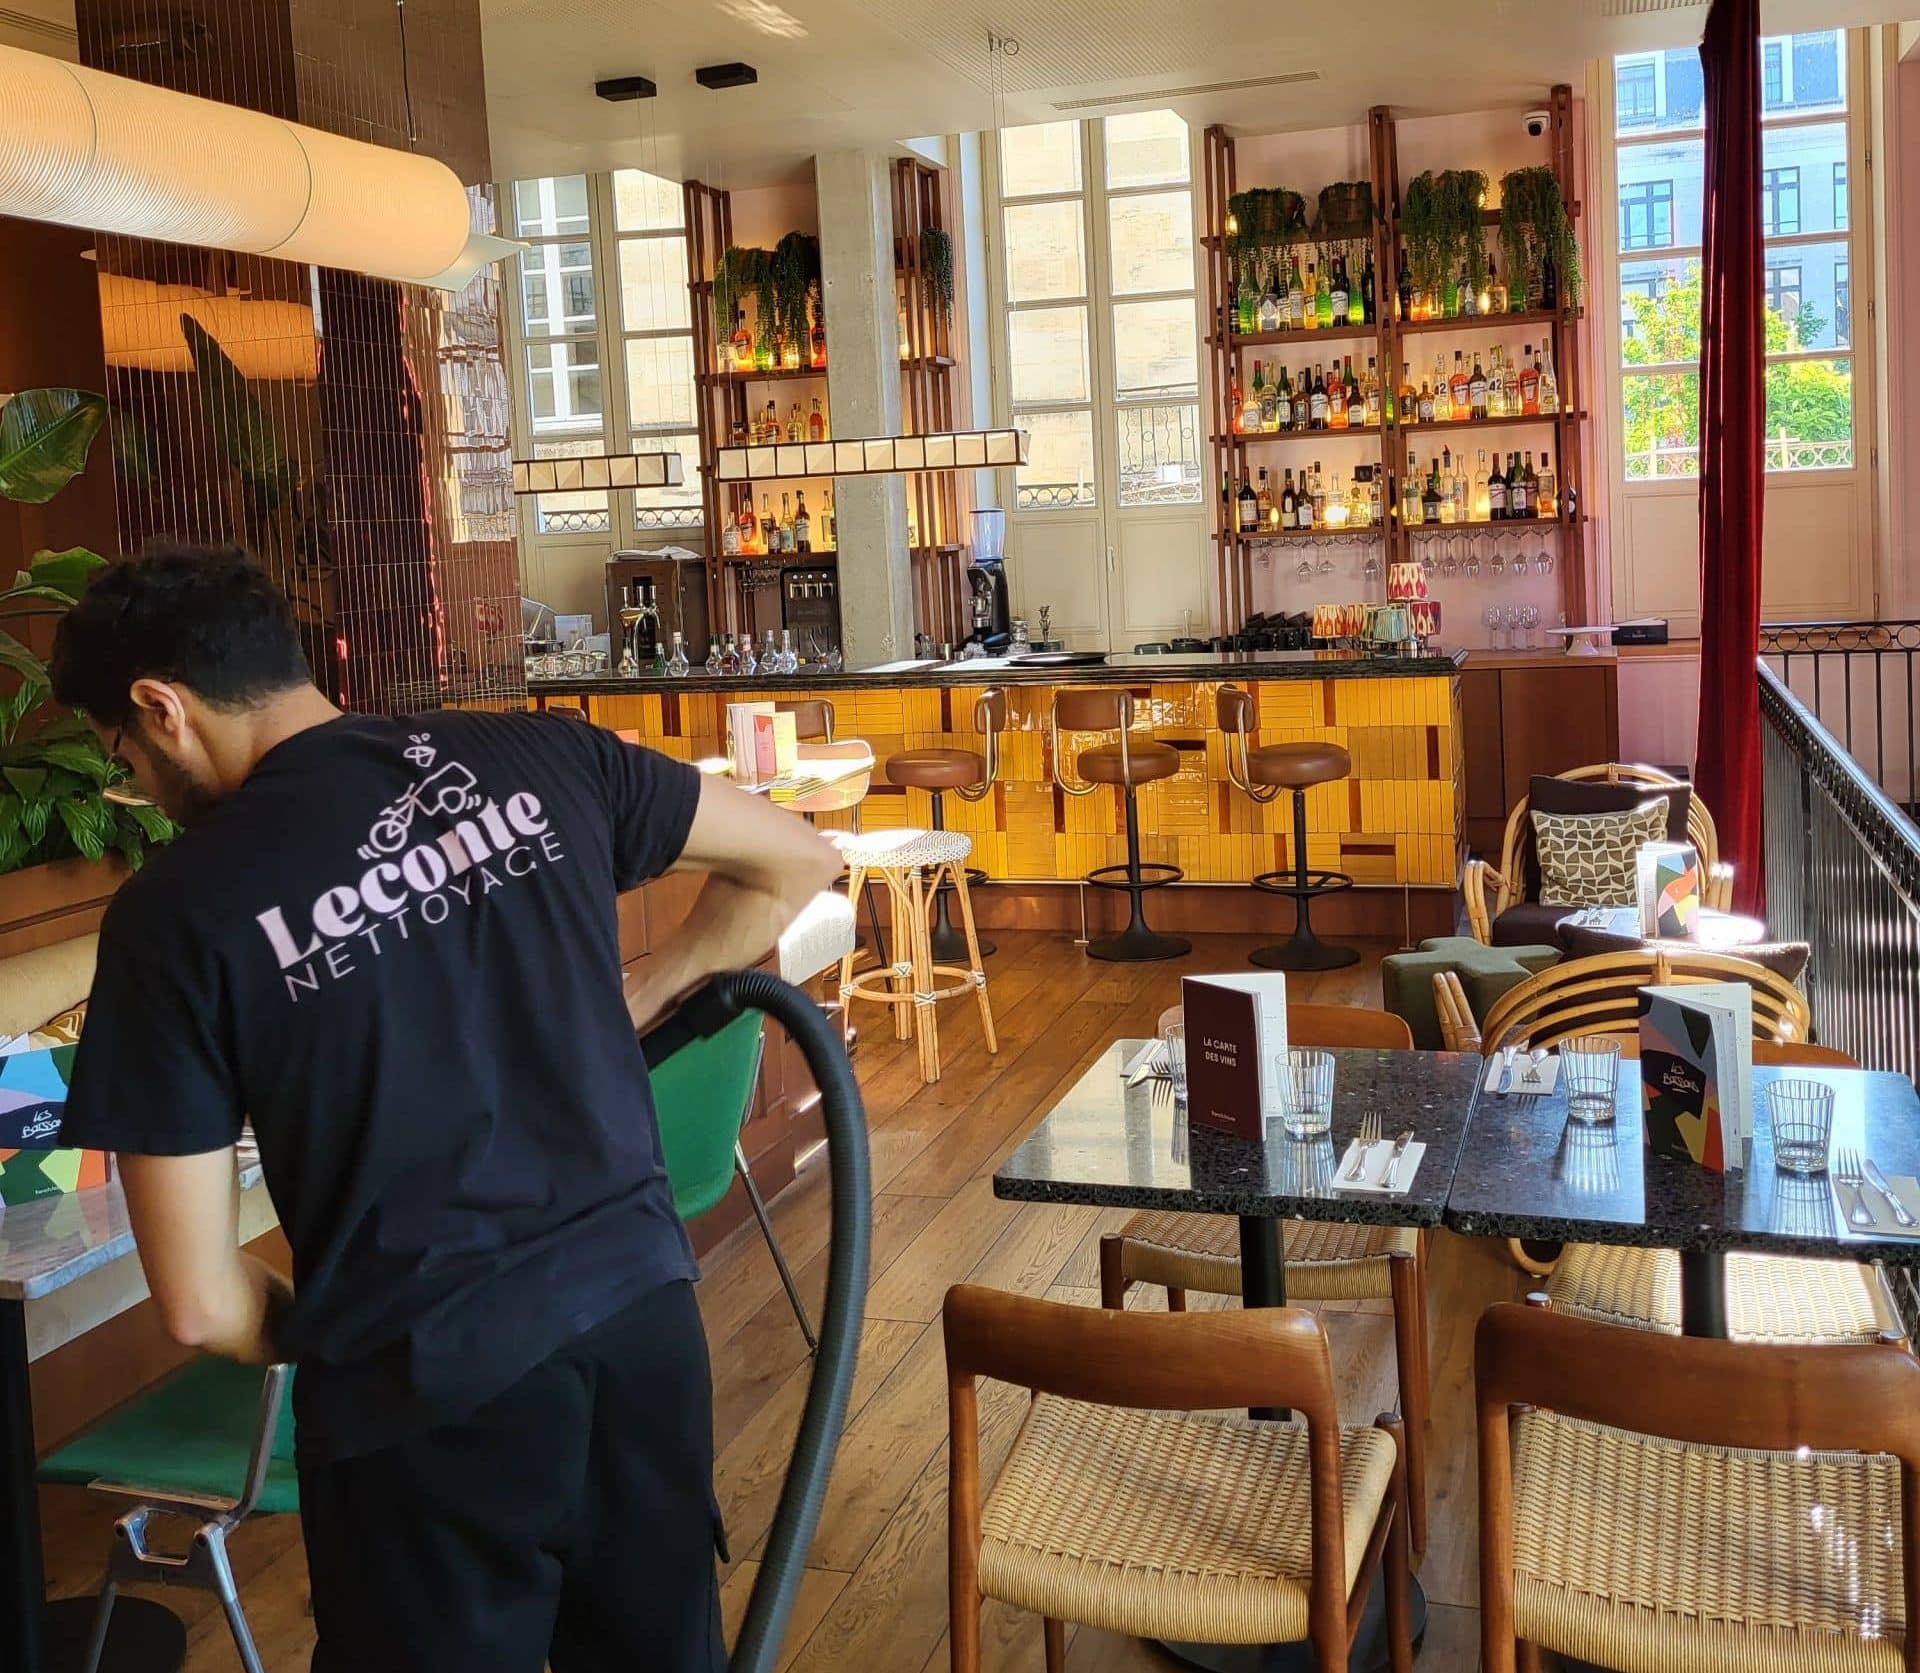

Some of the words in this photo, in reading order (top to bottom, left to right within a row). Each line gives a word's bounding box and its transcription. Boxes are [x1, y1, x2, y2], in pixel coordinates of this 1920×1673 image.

[256, 792, 548, 969] Leconte
[285, 832, 564, 1002] NETTOYAGE
[1203, 1036, 1212, 1047] LA
[1213, 1039, 1237, 1054] CARTE
[1205, 1051, 1218, 1063] DES
[1219, 1054, 1237, 1067] VINS
